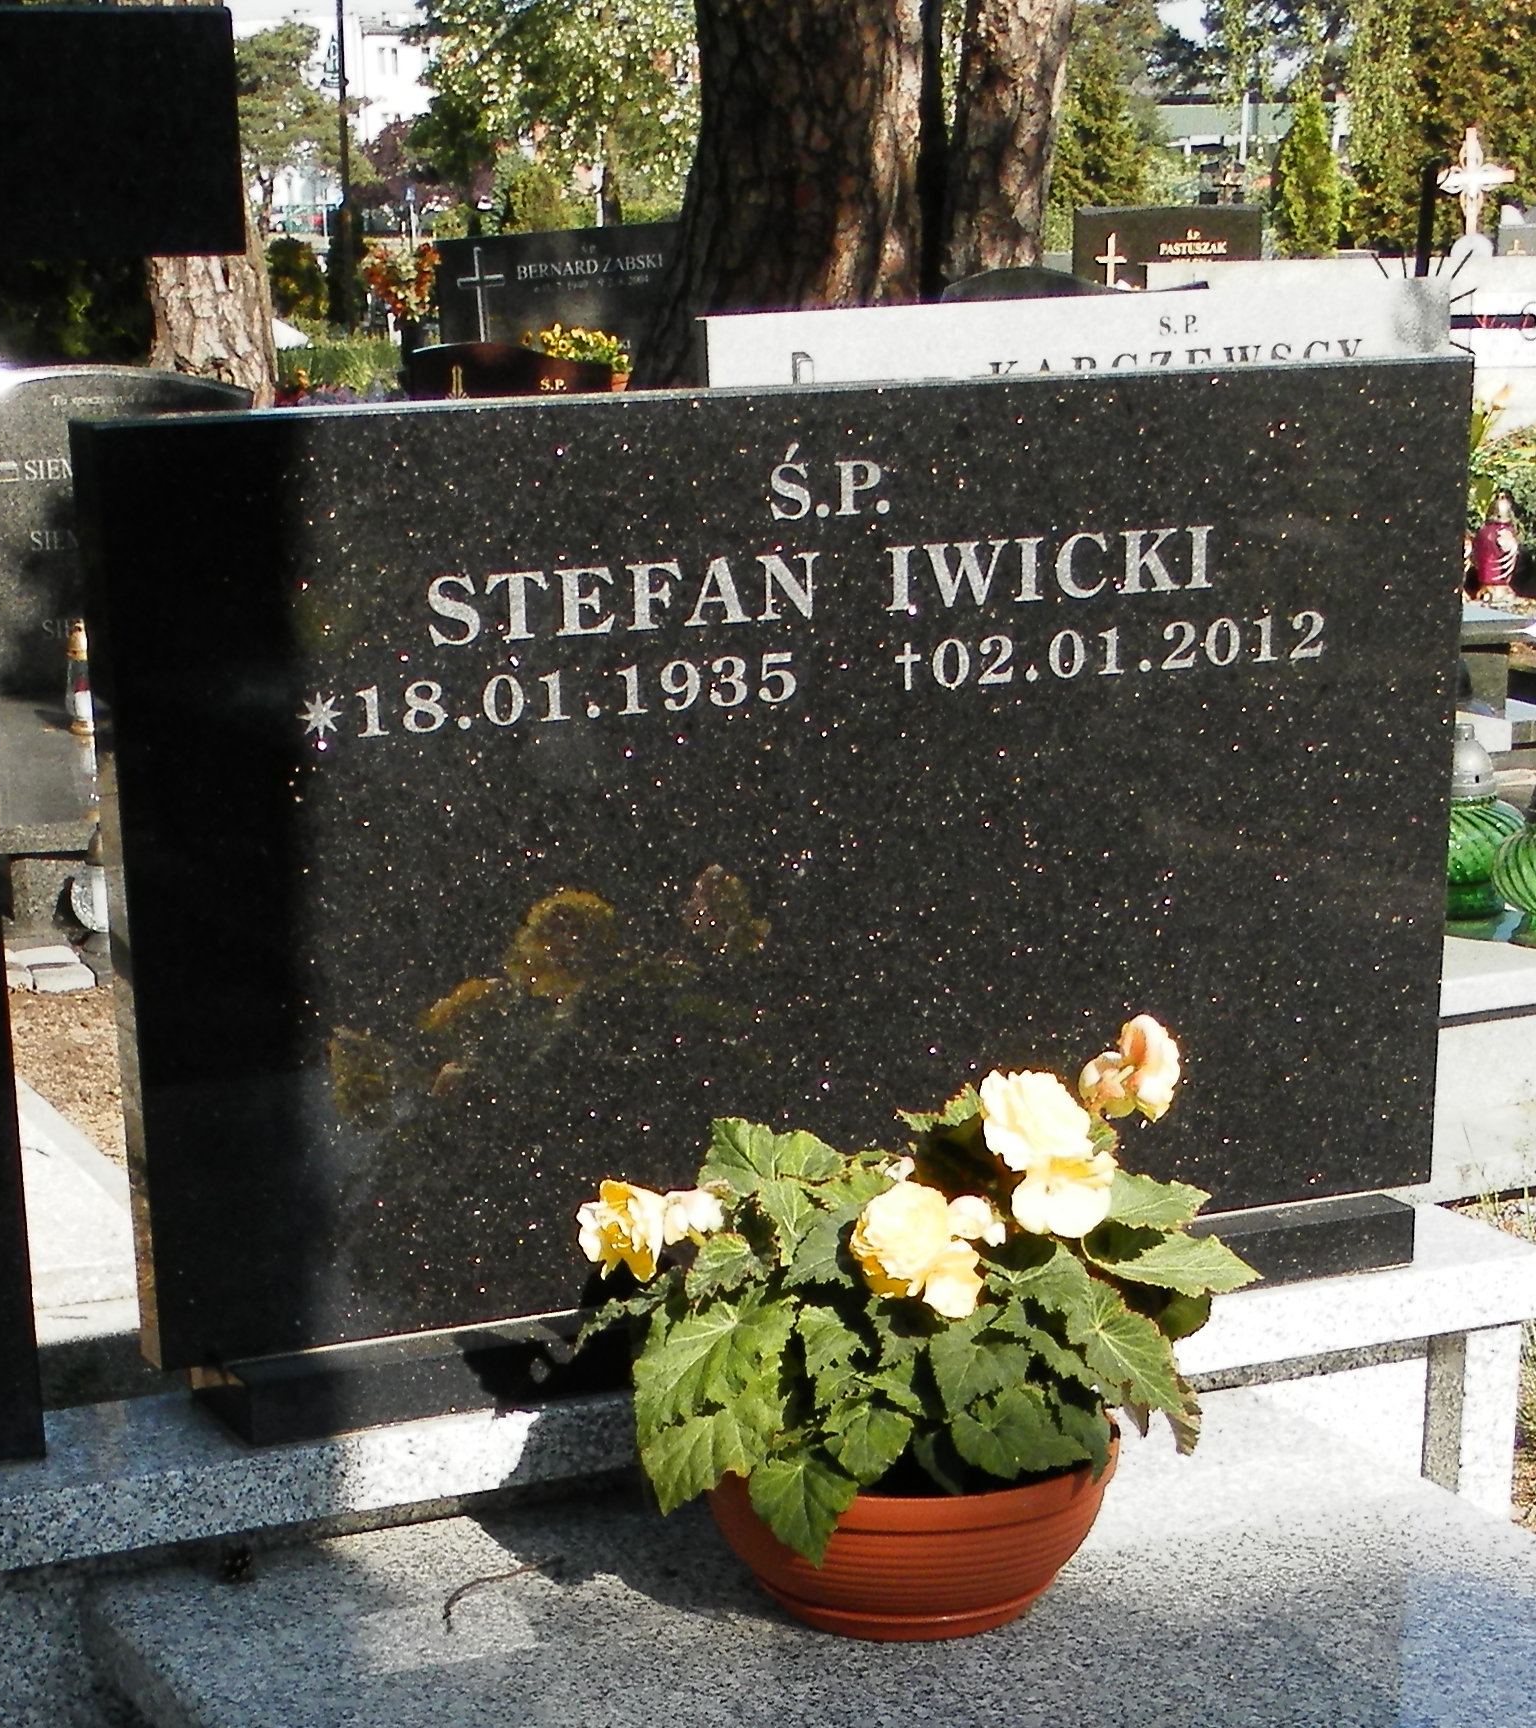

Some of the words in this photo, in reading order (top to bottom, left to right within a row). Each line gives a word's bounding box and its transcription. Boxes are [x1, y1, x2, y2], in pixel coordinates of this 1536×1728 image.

[517, 258, 598, 281] BERNARD
[1159, 240, 1227, 257] PASTUSZAK
[769, 441, 890, 522] Ś.P.
[426, 550, 821, 647] STEFAN
[884, 524, 1215, 613] IWICKI
